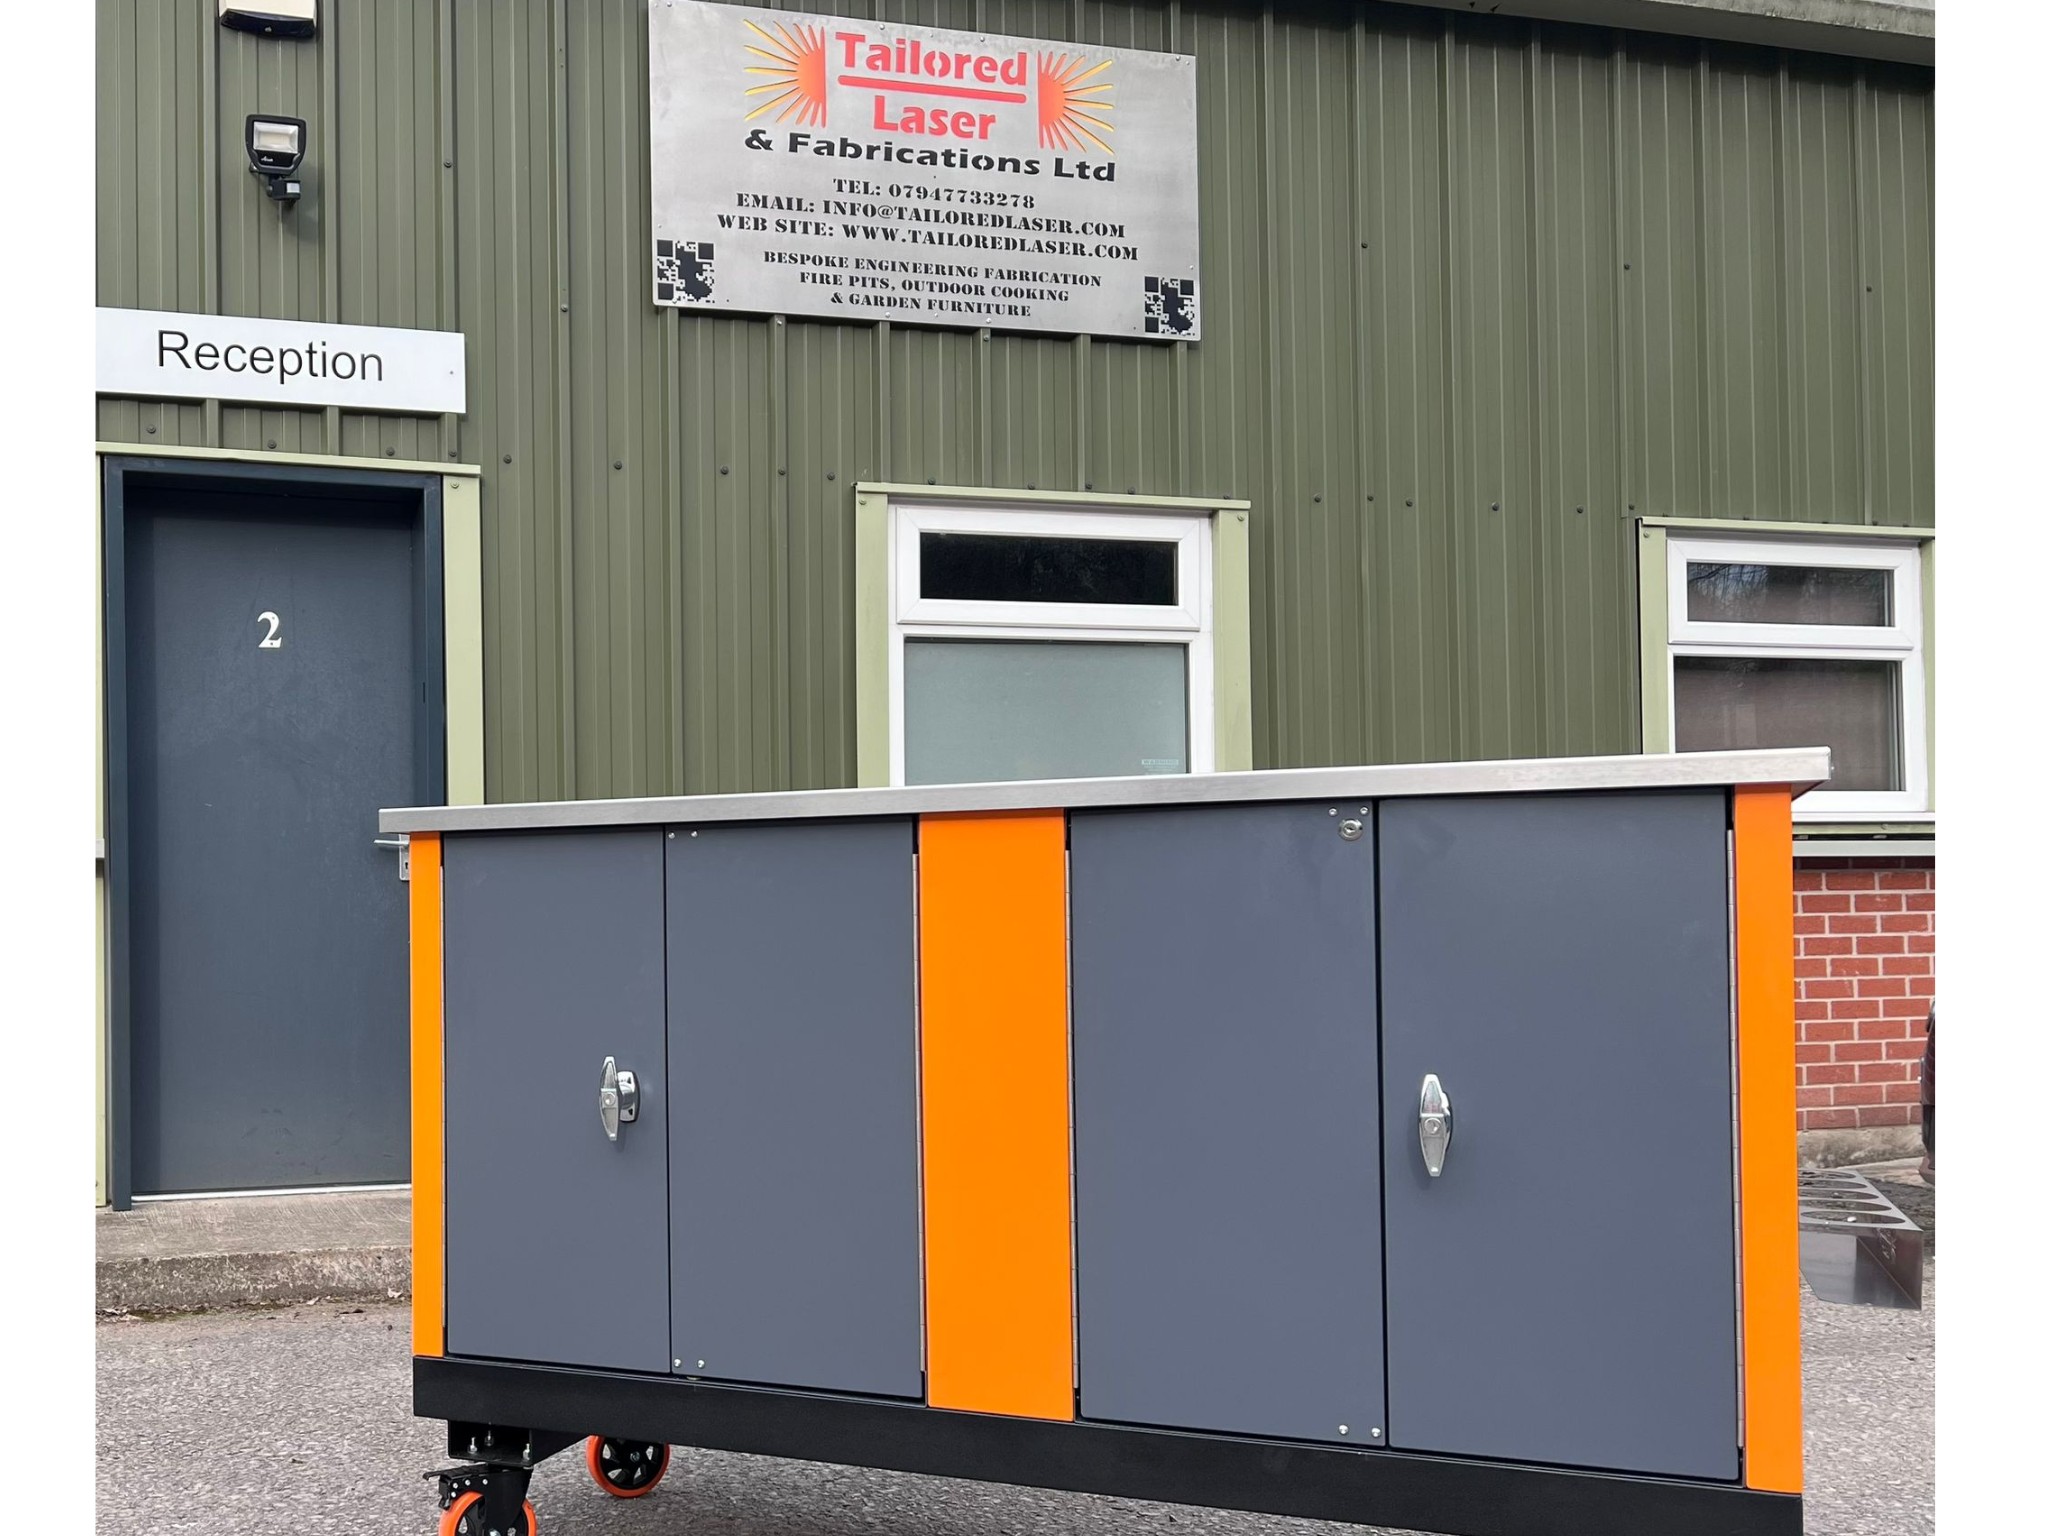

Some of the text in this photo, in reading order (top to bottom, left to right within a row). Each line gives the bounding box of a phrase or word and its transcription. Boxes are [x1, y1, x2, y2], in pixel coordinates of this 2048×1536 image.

[836, 32, 1027, 87] Tailored
[873, 94, 996, 140] Laser
[745, 129, 1116, 182] & Fabrications Ltd
[737, 192, 1125, 238] EMAIL: INFO@TAILOREDLASER.COM
[833, 178, 1035, 209] TEL: 07947733278
[717, 214, 1138, 261] WEB SITE: WWW.TAILOREDLASER.COM
[764, 251, 1101, 287] BESPOKE ENGINEERING FABRICATION
[800, 272, 1069, 302] FIRE PITS, OUTDOOR COOKING
[830, 292, 1031, 317] & GARDEN FURNITURE
[157, 330, 384, 385] Reception
[257, 611, 282, 649] 2
